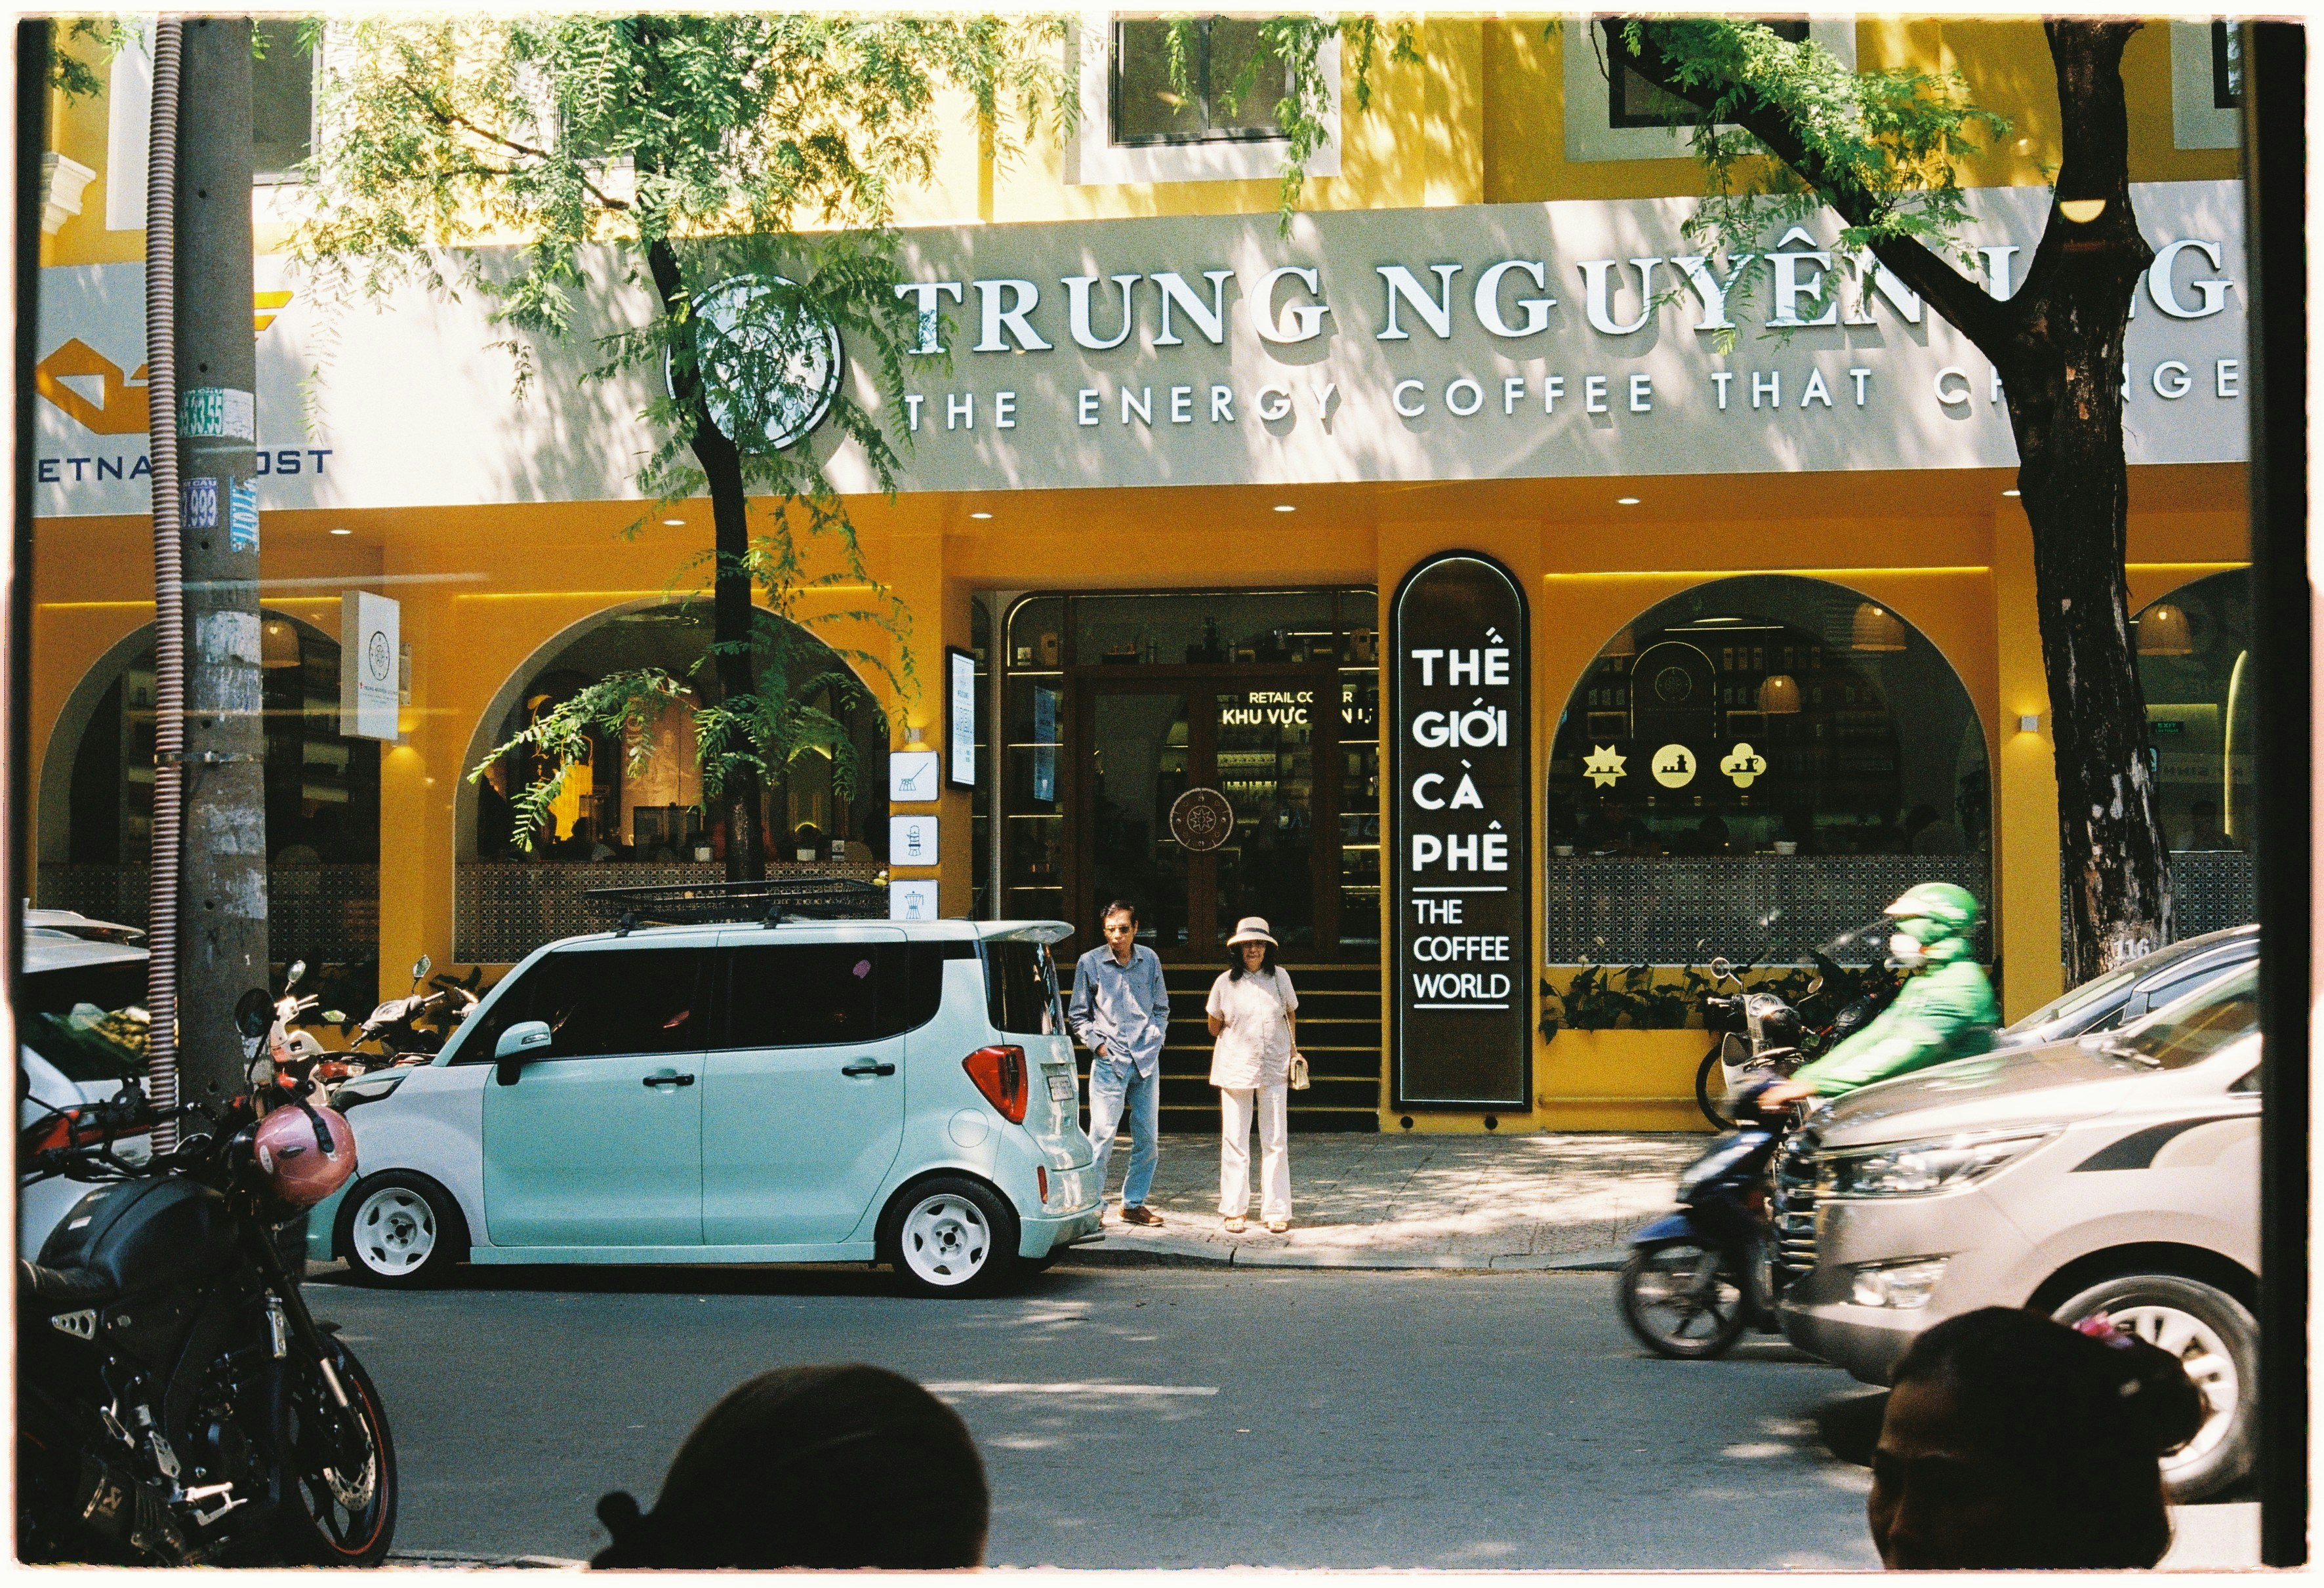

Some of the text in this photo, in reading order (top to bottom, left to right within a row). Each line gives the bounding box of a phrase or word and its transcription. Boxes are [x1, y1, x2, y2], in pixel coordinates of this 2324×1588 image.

[893, 266, 1330, 355] TRUNG
[1376, 226, 1931, 340] NGUYÊN
[905, 359, 2239, 430] THE ENERGY COFFEE THAT CGE
[38, 449, 333, 483] ETNA OST
[1412, 626, 1509, 686] THẾ
[1249, 691, 1353, 703] RETAIL COR
[1223, 706, 1308, 728] KHU VỰC
[1412, 697, 1507, 748] GIỚI
[1412, 759, 1484, 810] CÀ
[1412, 820, 1508, 872] PHÊ
[1412, 899, 1463, 924] THE
[1413, 936, 1510, 962] COFFEE
[2113, 937, 2150, 960] 116
[1412, 973, 1511, 999] WORLD
